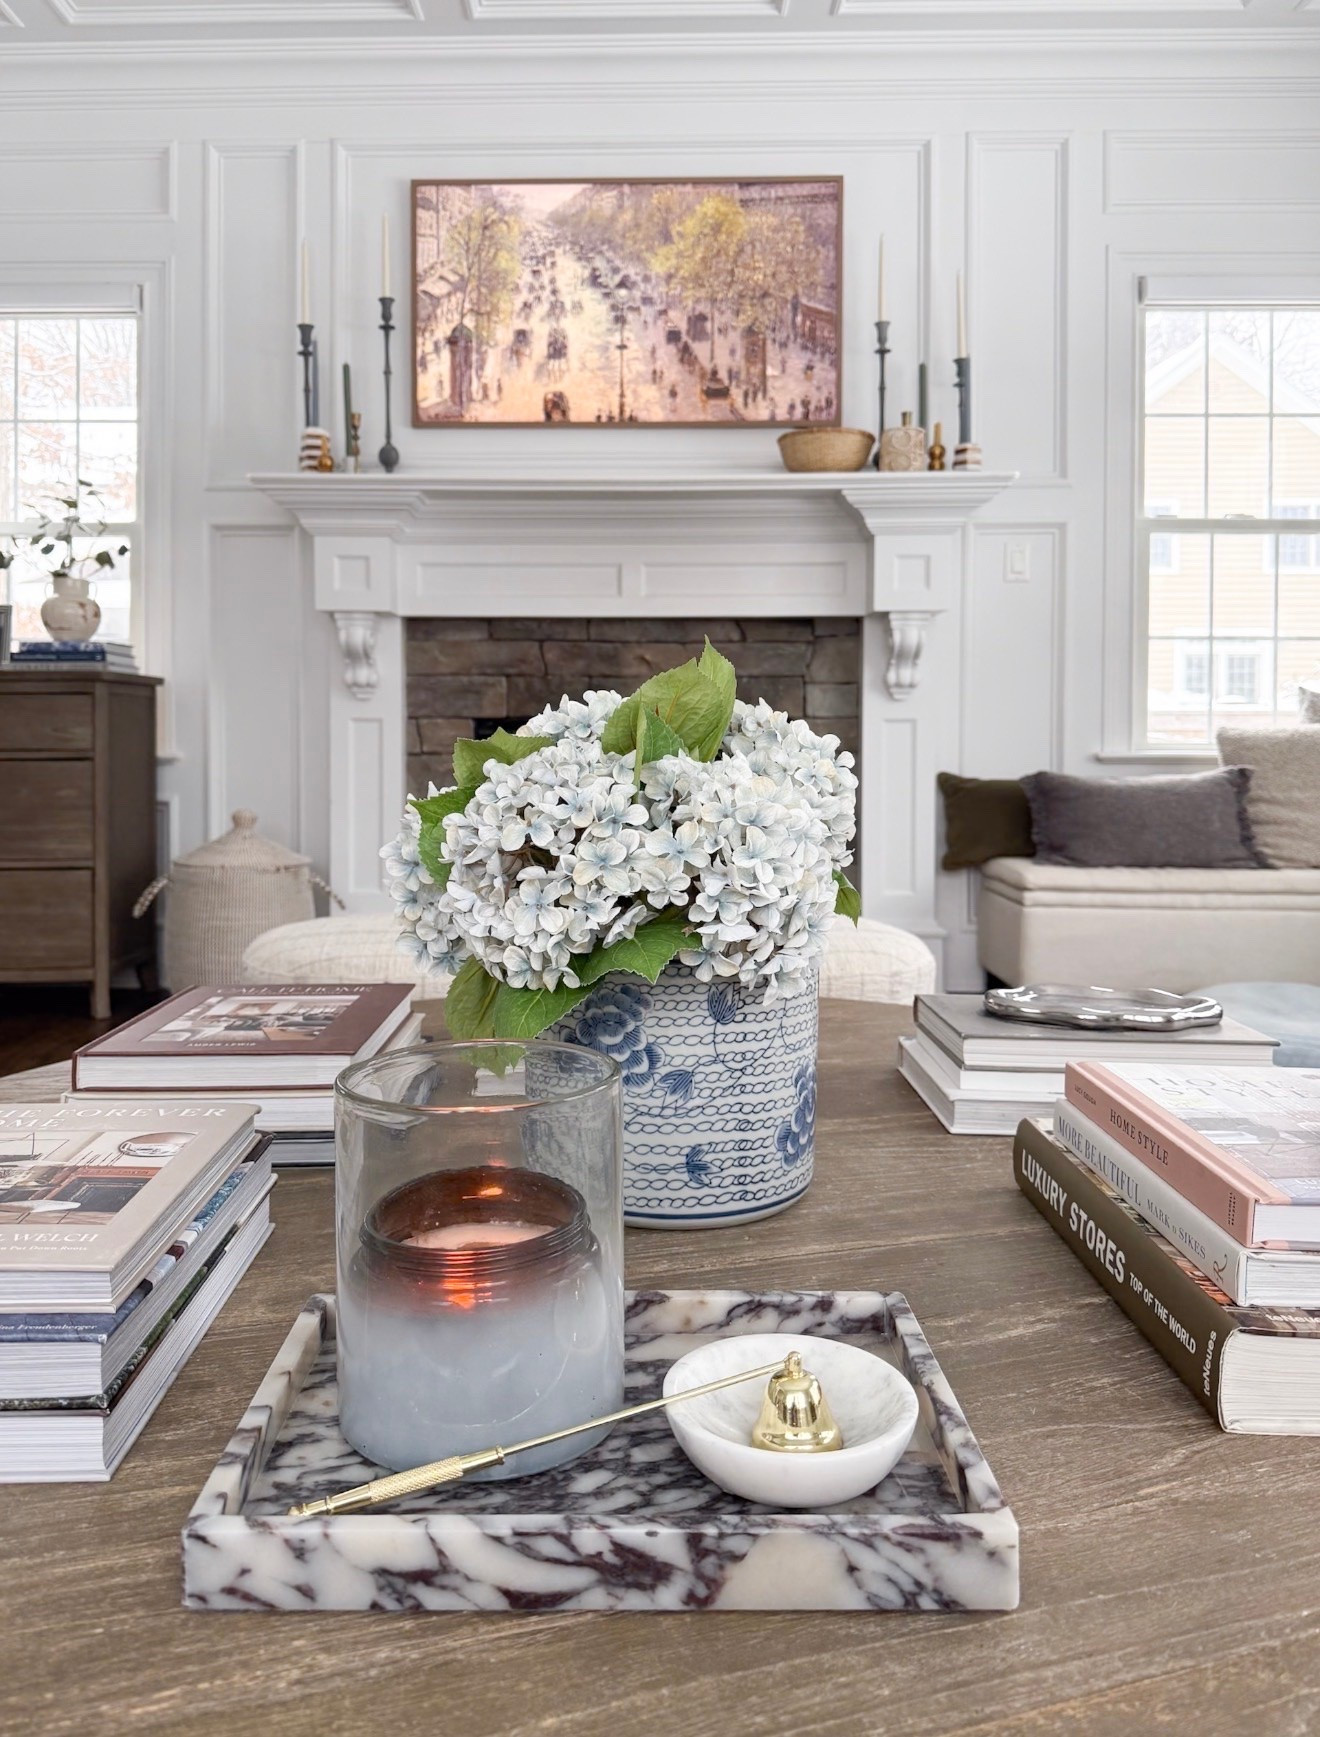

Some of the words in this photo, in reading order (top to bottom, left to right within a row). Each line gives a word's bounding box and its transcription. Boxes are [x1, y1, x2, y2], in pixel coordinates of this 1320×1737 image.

[0, 1108, 42, 1117] HE
[53, 1108, 227, 1118] FOREVER
[1110, 1108, 1136, 1140] HOME
[1138, 1131, 1169, 1166] STYLE
[1058, 1115, 1083, 1152] MORE
[1084, 1139, 1141, 1207] BEAUTIFUL
[1147, 1199, 1170, 1228] MARK
[1178, 1227, 1206, 1259] SIKES
[14, 1233, 99, 1242] WELCH
[1021, 1148, 1068, 1217] LUXURY
[1069, 1202, 1126, 1284] STORES
[1129, 1272, 1143, 1295] TOP
[1143, 1288, 1154, 1306] OF
[1153, 1298, 1168, 1324] THE
[1168, 1316, 1196, 1354] WORLD
[1264, 1313, 1320, 1323] teNeue
[1203, 1330, 1217, 1397] teNeues
